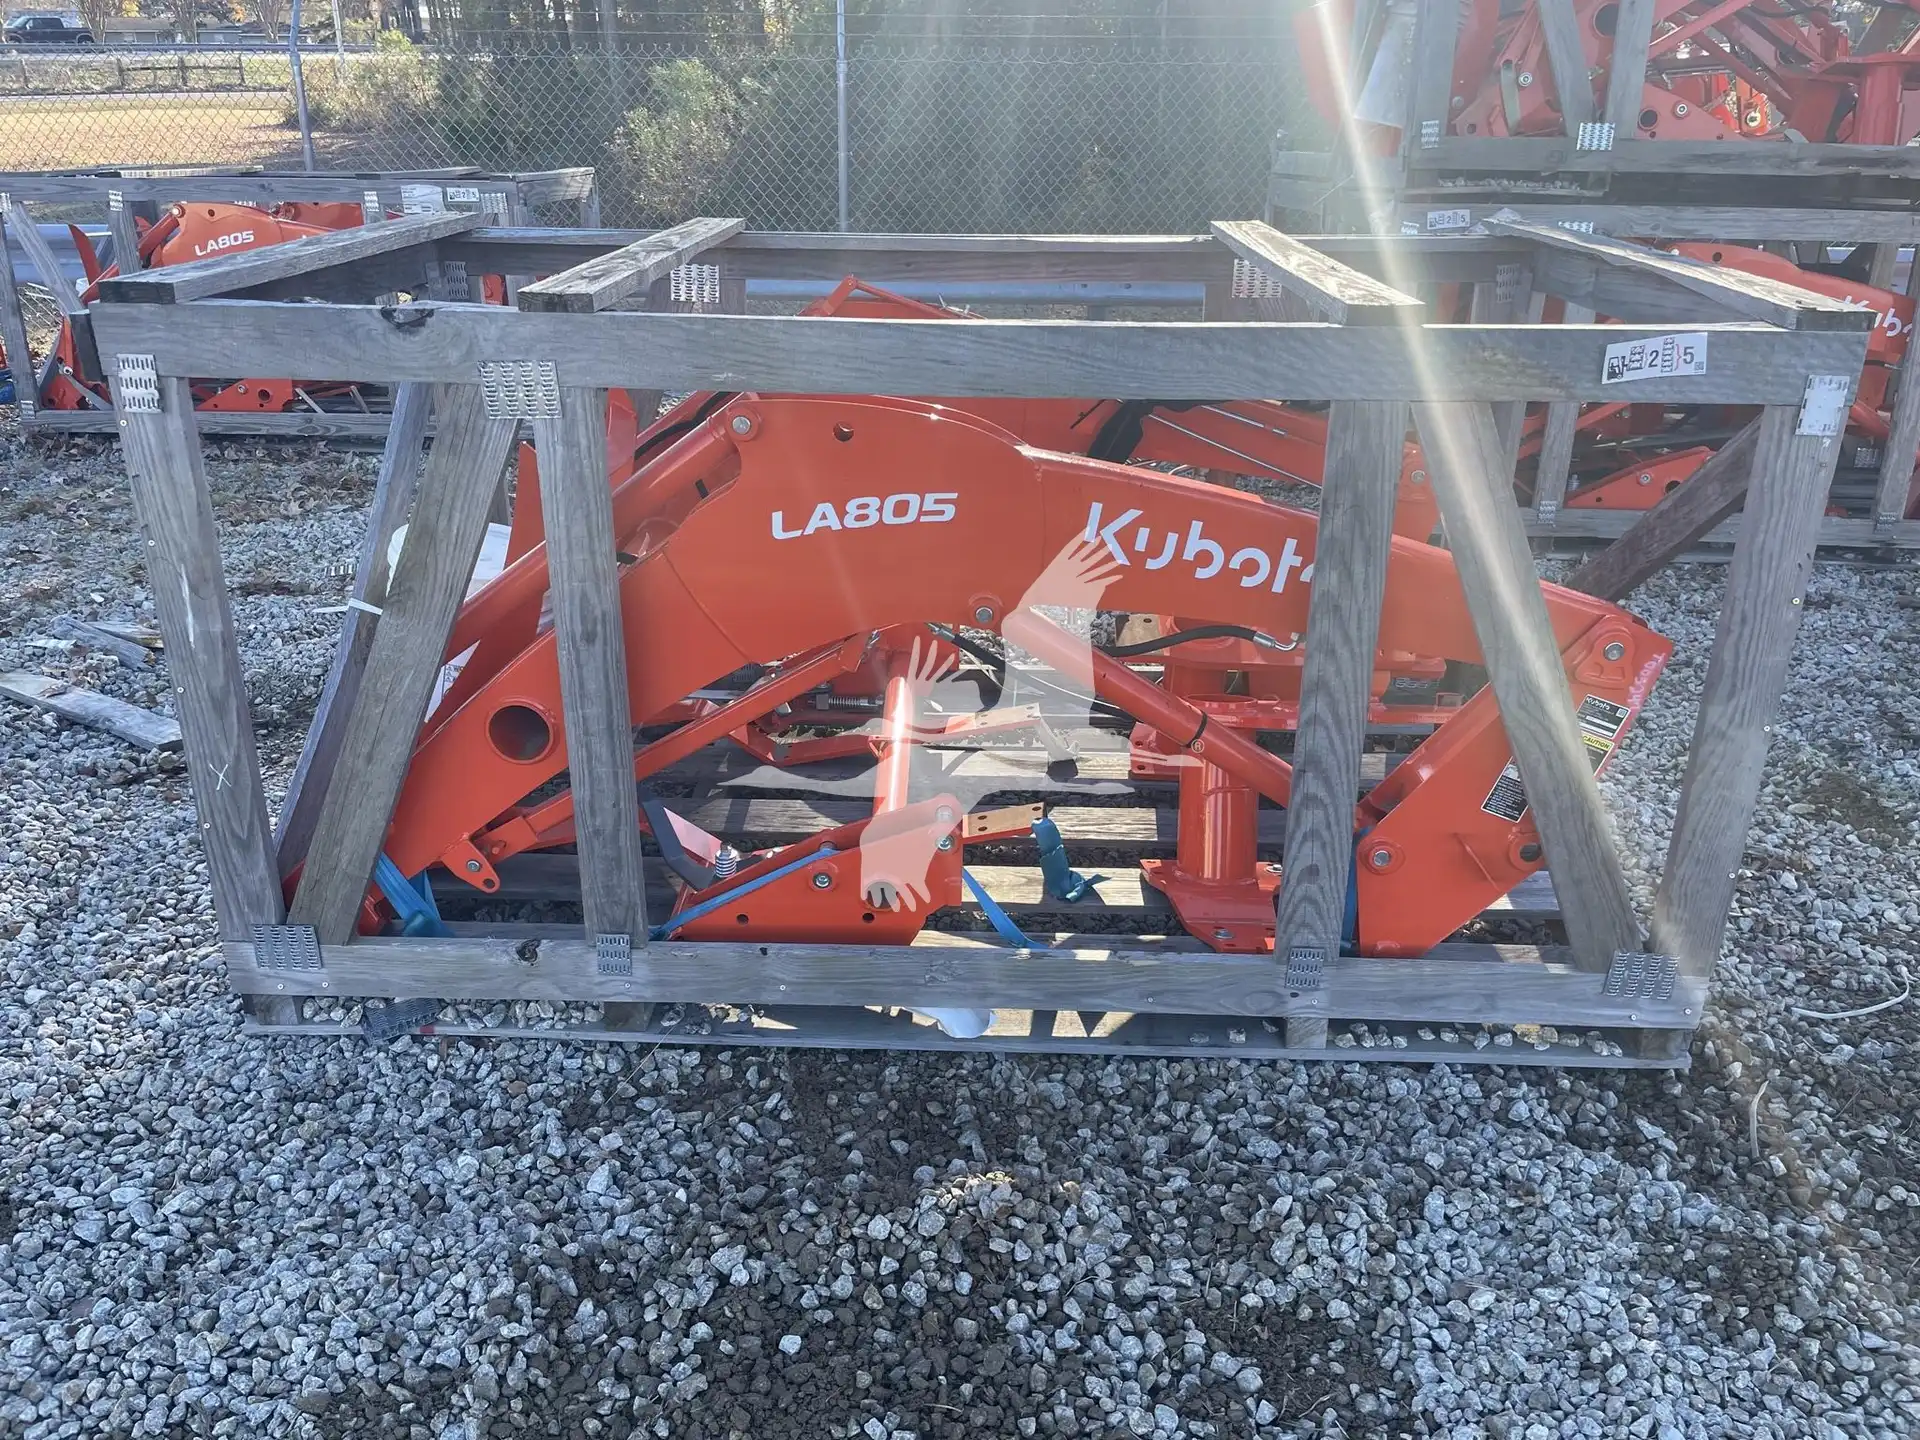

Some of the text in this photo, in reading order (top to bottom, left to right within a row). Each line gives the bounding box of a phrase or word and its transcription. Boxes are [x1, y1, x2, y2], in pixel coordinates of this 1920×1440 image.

[194, 230, 255, 257] LA805
[1648, 345, 1695, 368] 2 5
[771, 492, 959, 540] LA805
[1586, 697, 1611, 711] Kubota
[1583, 735, 1611, 750] CAUTION
